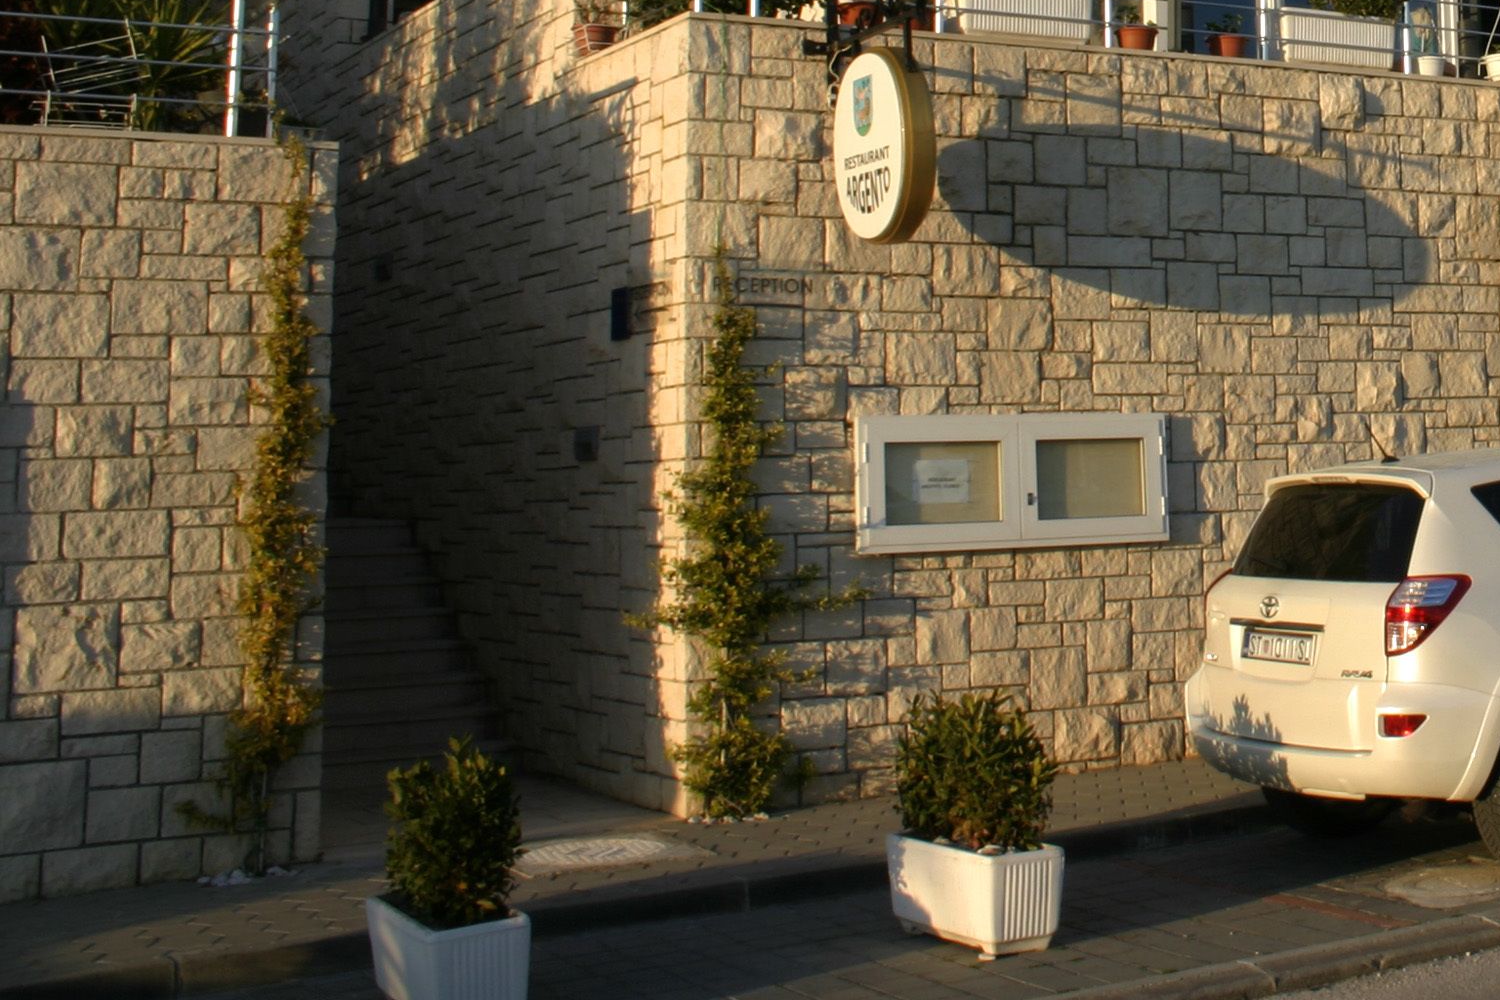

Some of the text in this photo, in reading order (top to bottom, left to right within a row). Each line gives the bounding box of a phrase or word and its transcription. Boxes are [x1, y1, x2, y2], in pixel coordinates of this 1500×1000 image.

[844, 145, 890, 171] RESTAURANT
[846, 165, 891, 214] ARGENTO
[1249, 634, 1262, 656] ST
